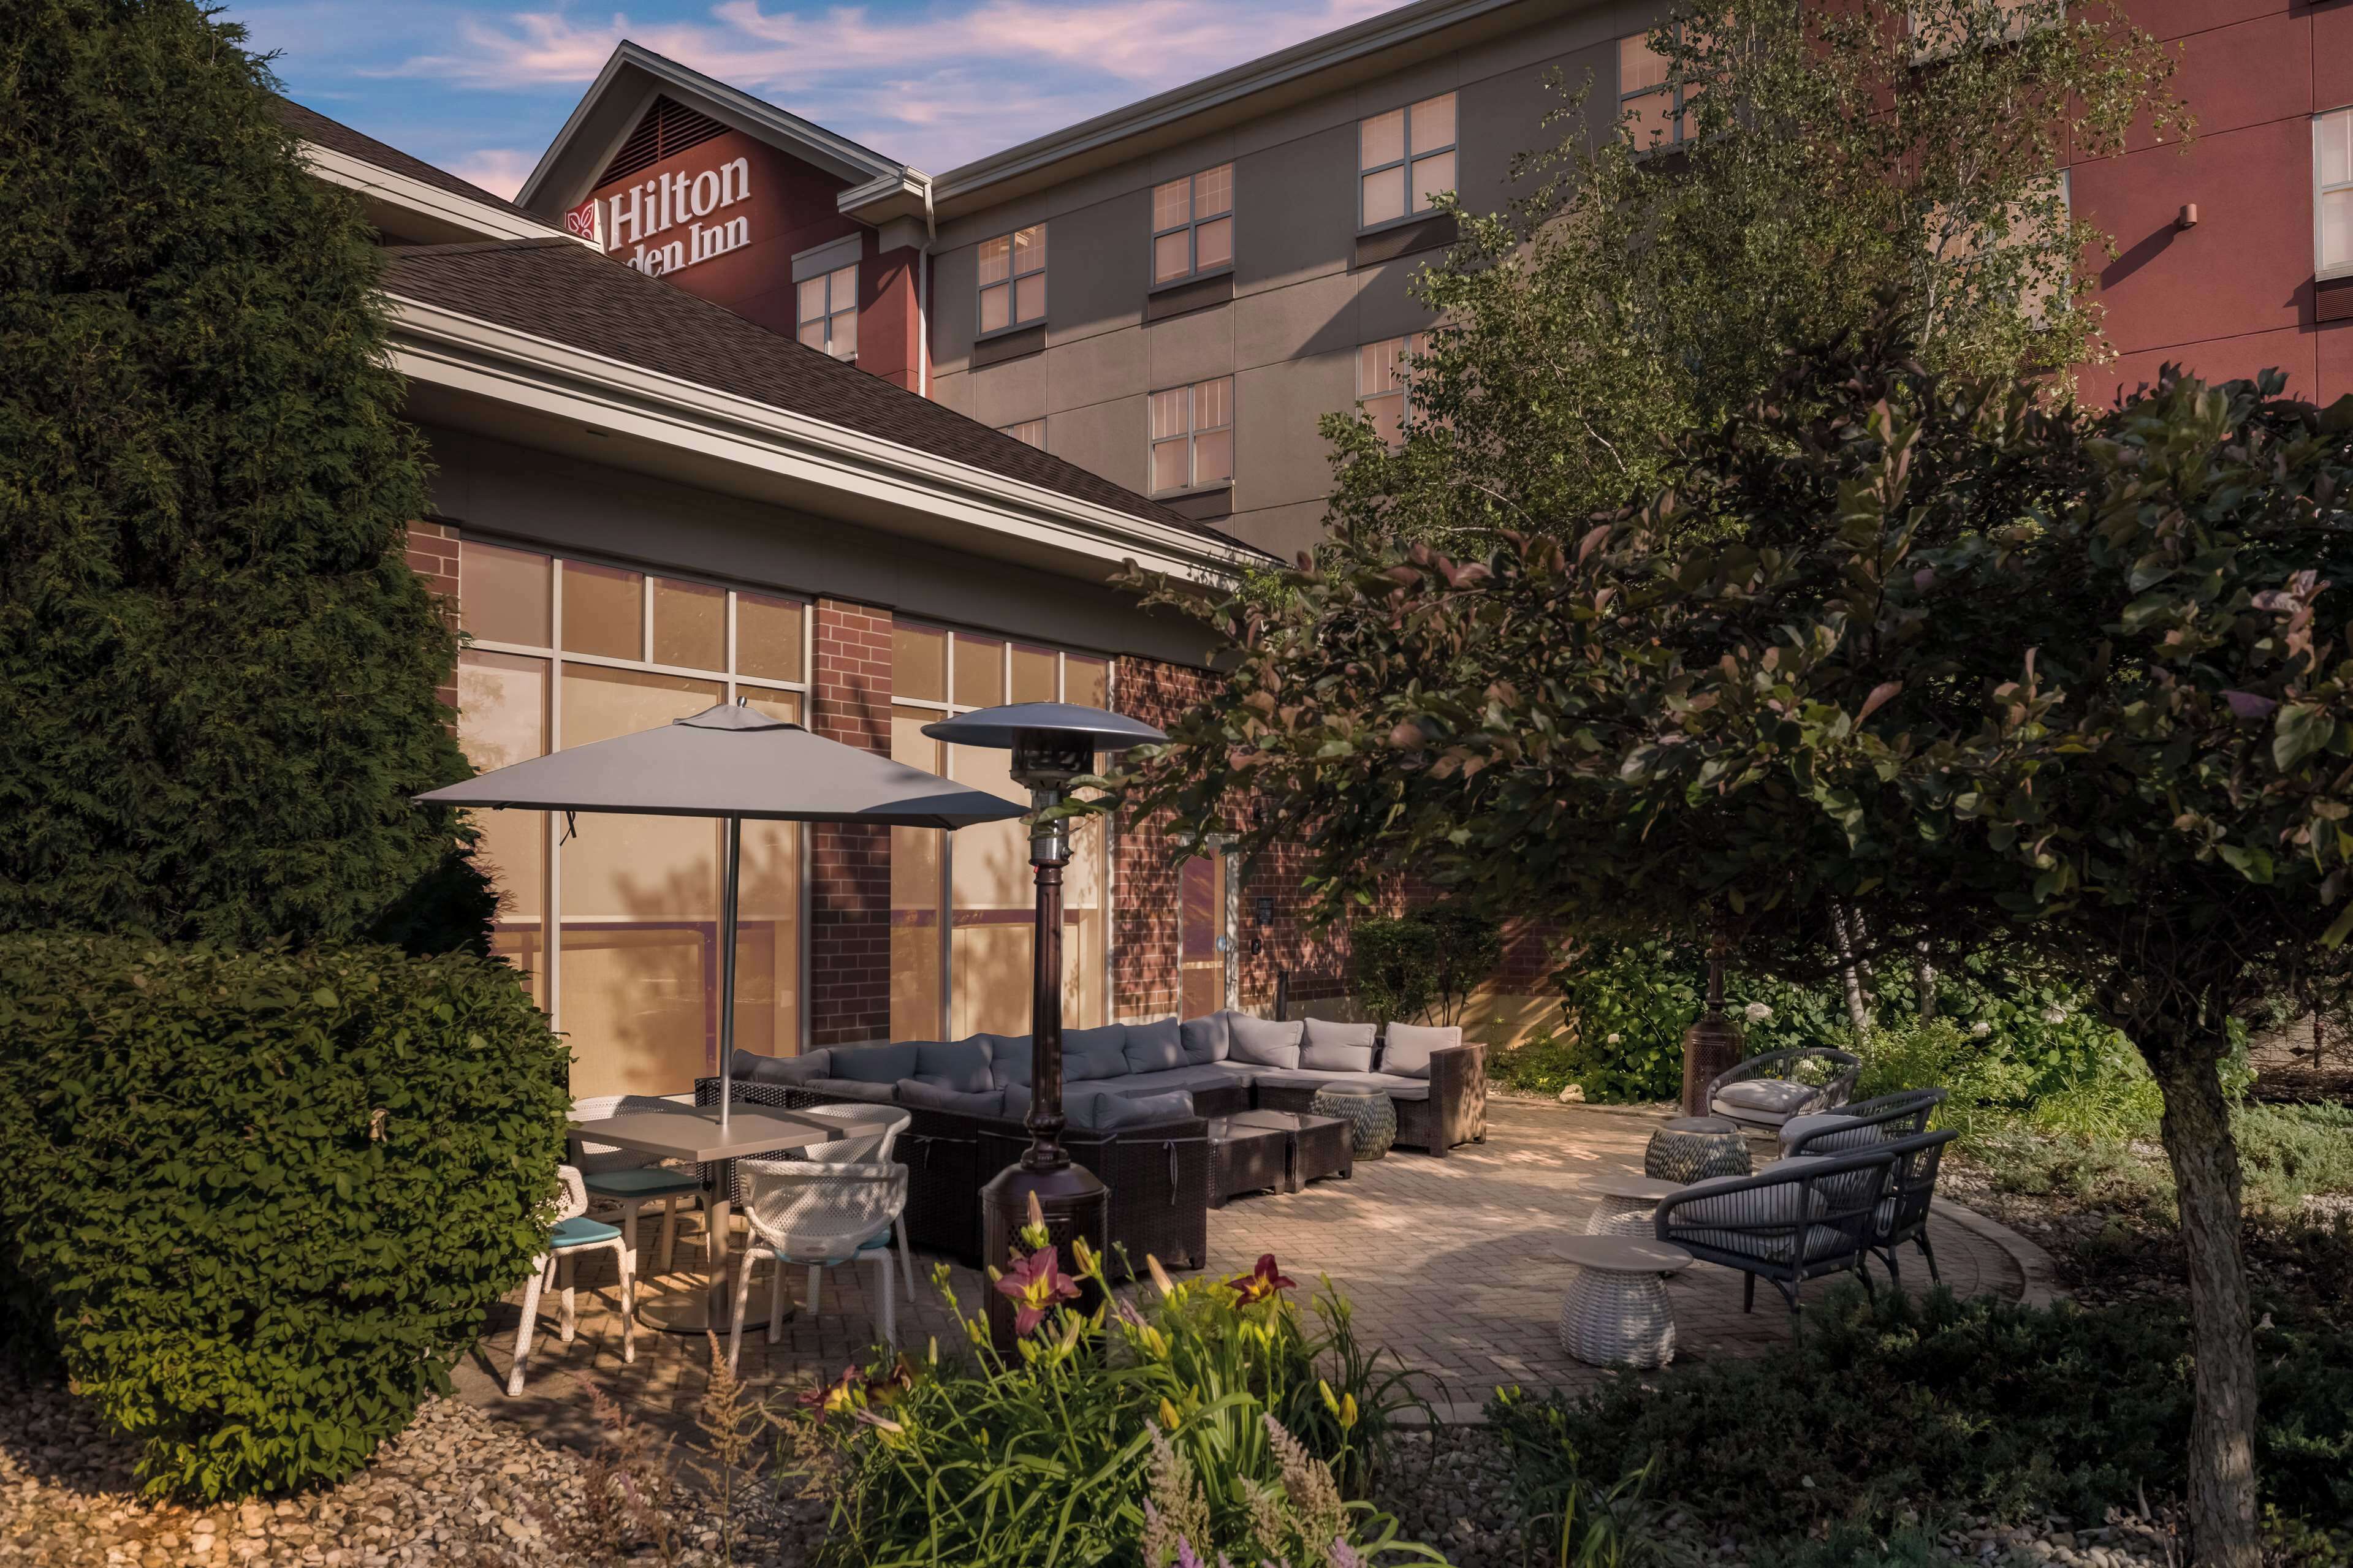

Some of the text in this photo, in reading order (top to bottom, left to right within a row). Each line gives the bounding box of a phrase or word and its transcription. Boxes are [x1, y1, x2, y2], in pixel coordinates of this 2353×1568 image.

[609, 157, 751, 251] Hilton
[622, 216, 751, 279] den Inn
